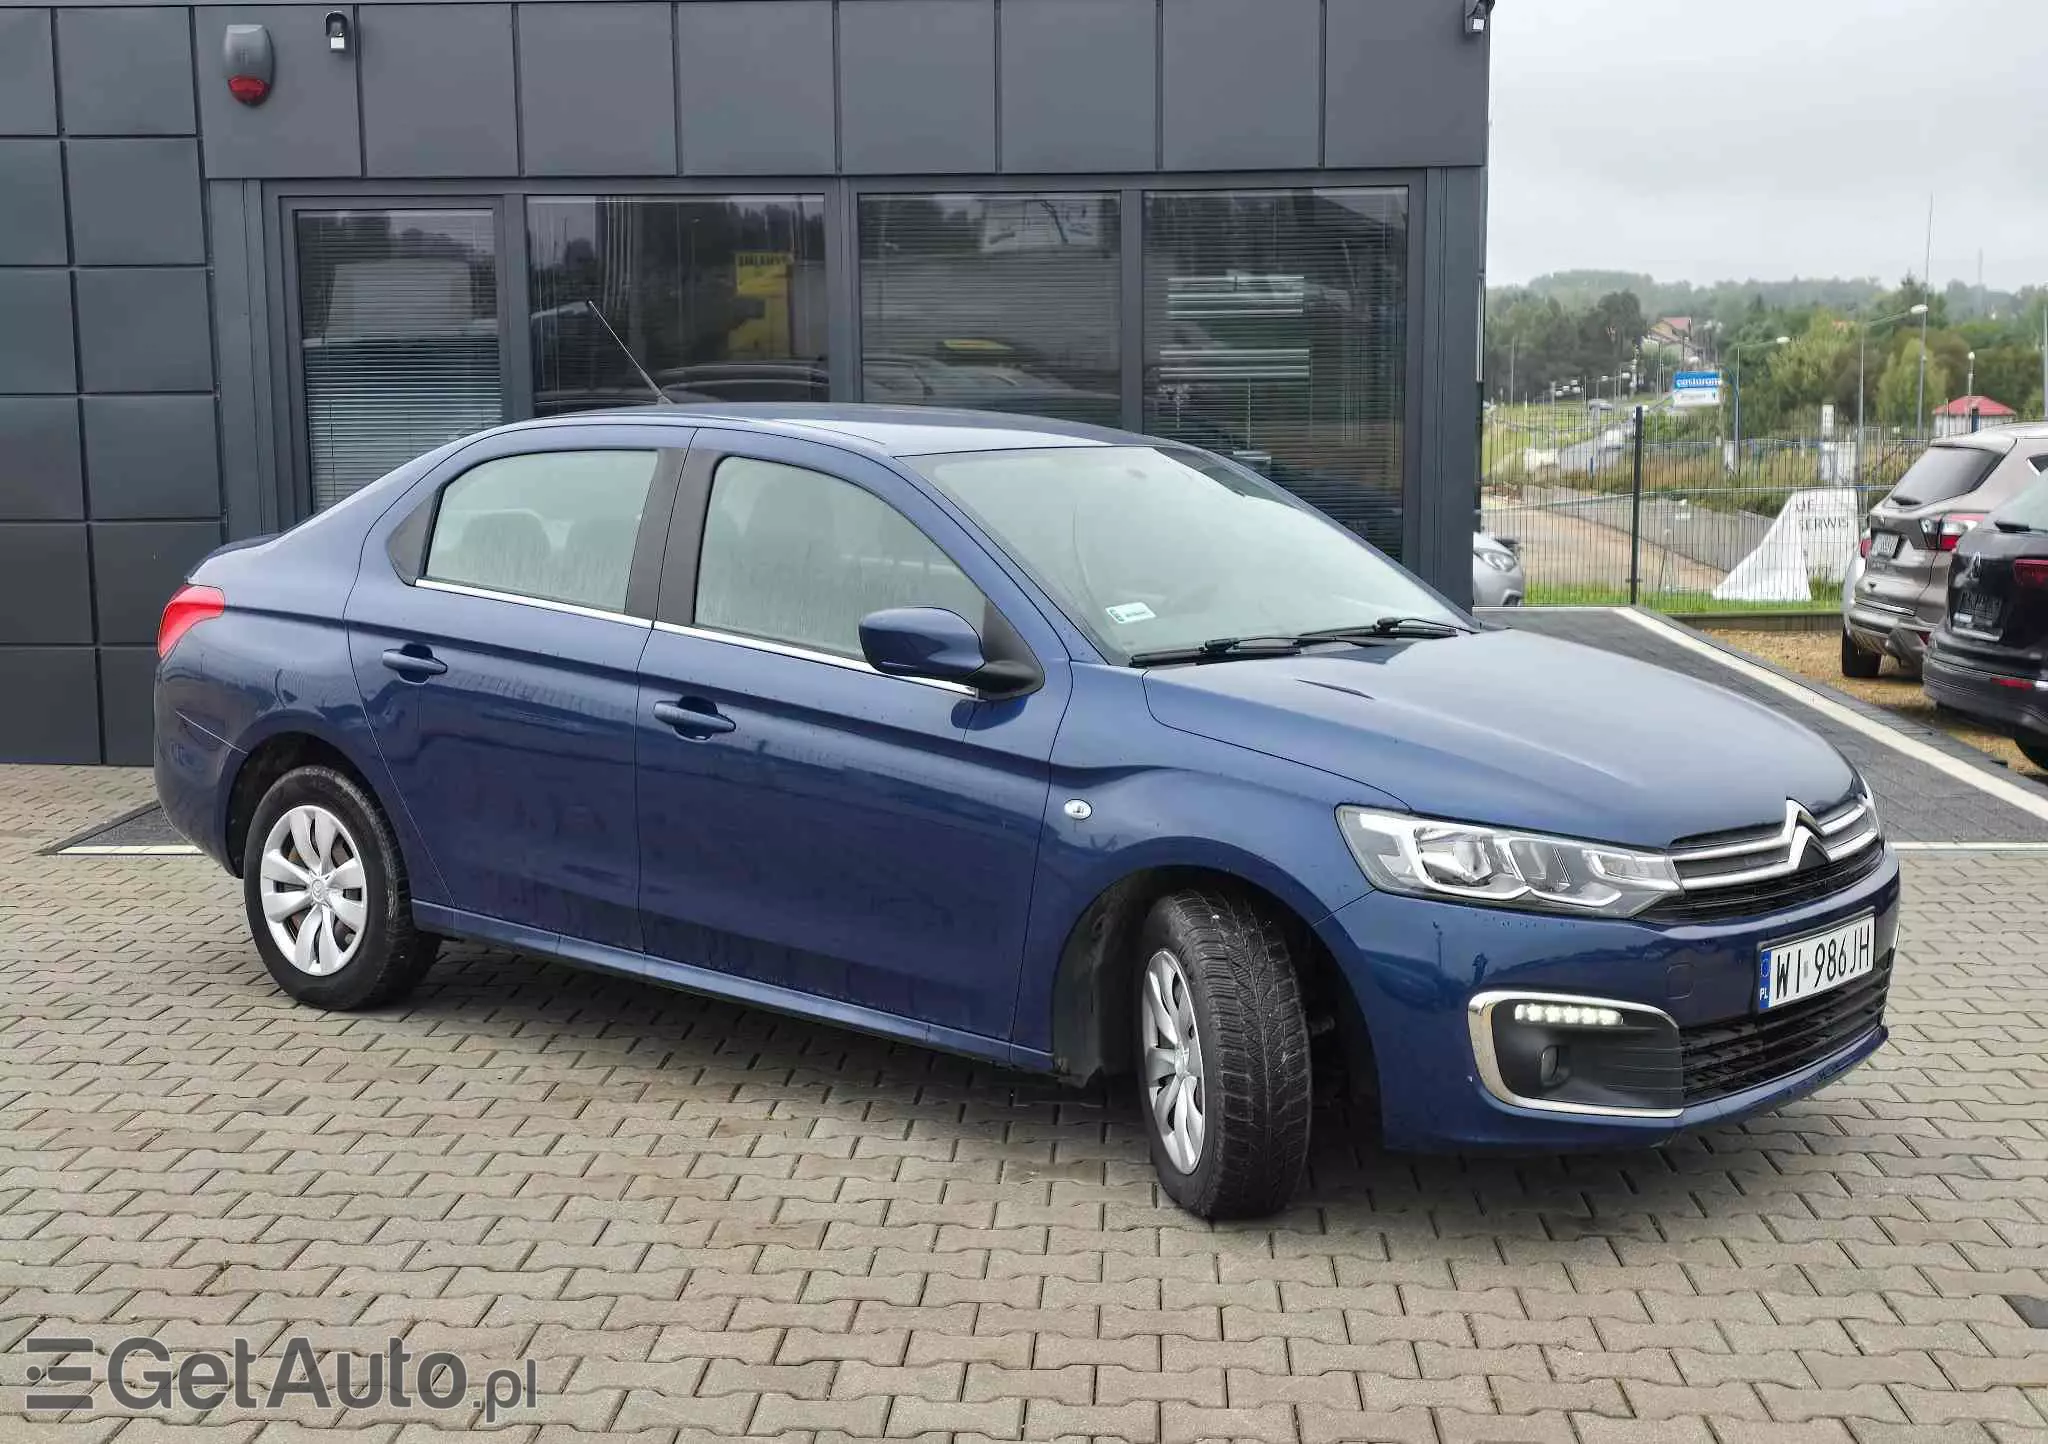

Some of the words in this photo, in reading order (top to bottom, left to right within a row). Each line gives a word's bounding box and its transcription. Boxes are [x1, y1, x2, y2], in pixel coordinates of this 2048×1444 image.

[1776, 947, 1801, 999] WI
[1814, 923, 1870, 988] 986JH
[1760, 987, 1769, 1001] PL
